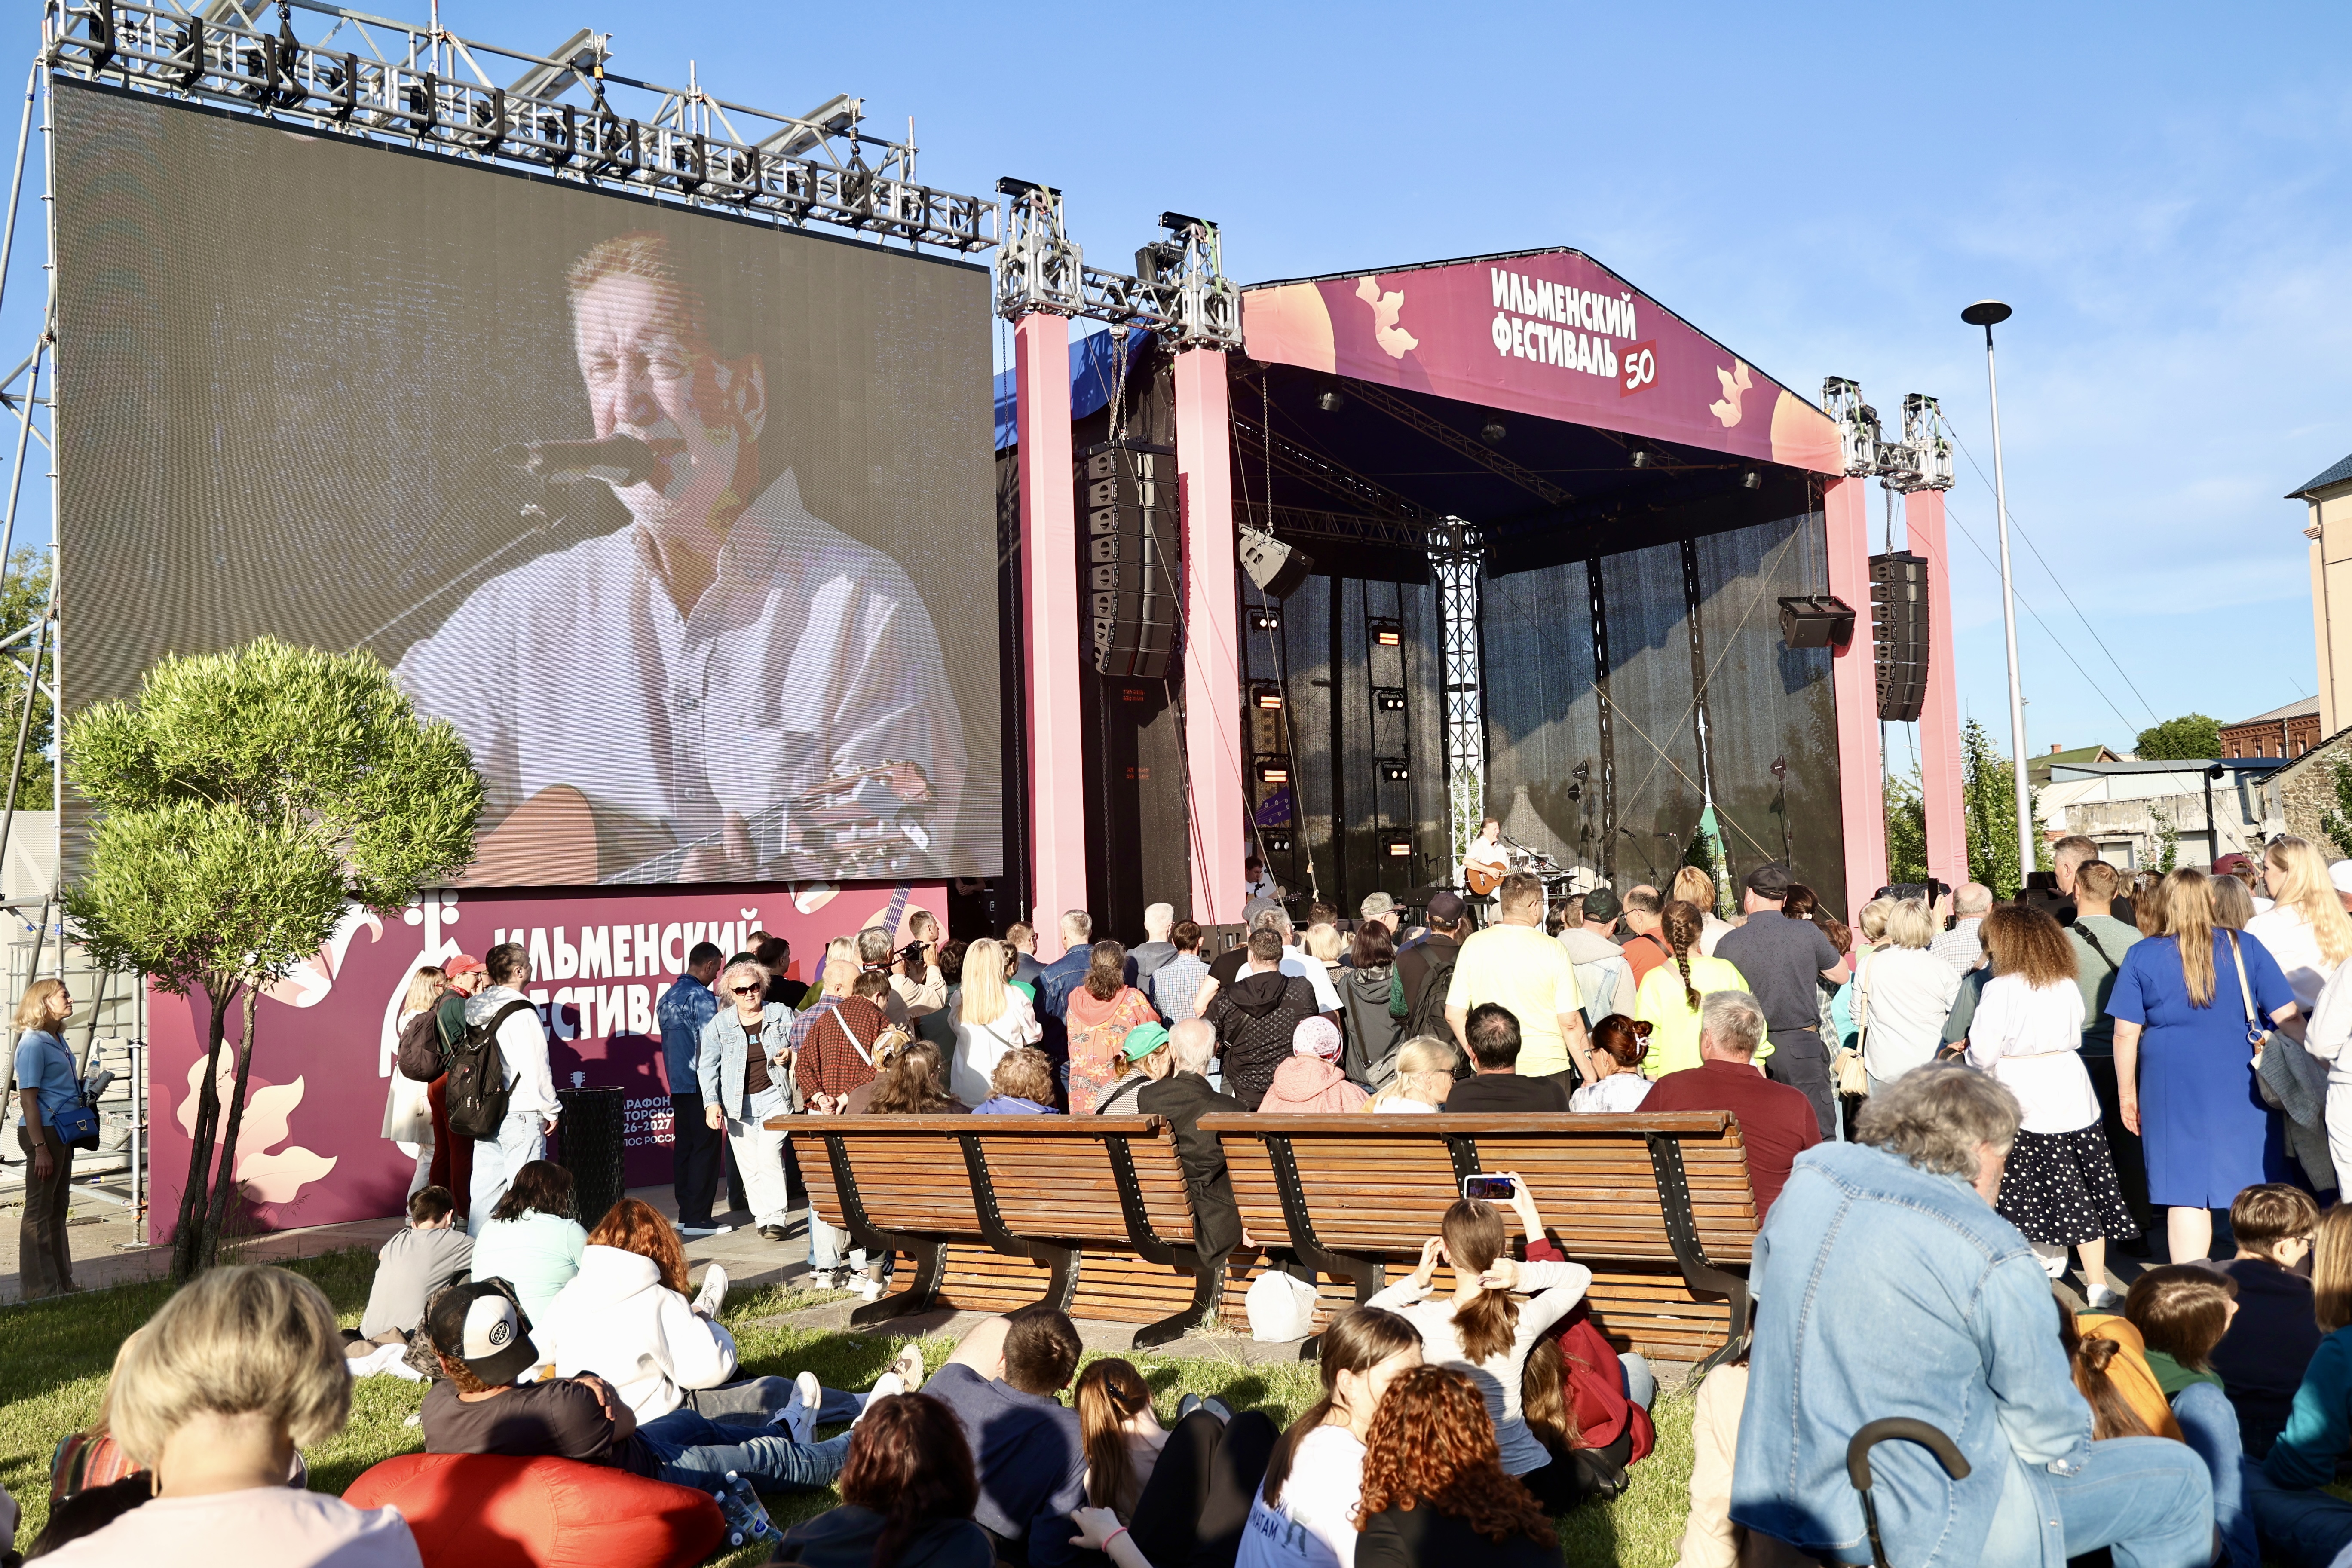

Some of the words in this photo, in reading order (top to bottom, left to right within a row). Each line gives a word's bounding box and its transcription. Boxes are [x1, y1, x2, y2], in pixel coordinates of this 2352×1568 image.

[1491, 267, 1637, 341] ИЛЬМЕНСКИЙ
[1491, 312, 1618, 378] ФЕСТИВАЛЬ
[1625, 349, 1655, 389] 50
[494, 907, 763, 983] ЛЬМЕНСКИЙ
[529, 983, 714, 1041] ЕСТИВ
[624, 1096, 670, 1110] РАФОН
[624, 1107, 674, 1121] ТОРСКО
[623, 1118, 671, 1133] 26-2027
[644, 1133, 676, 1145] РОССИ
